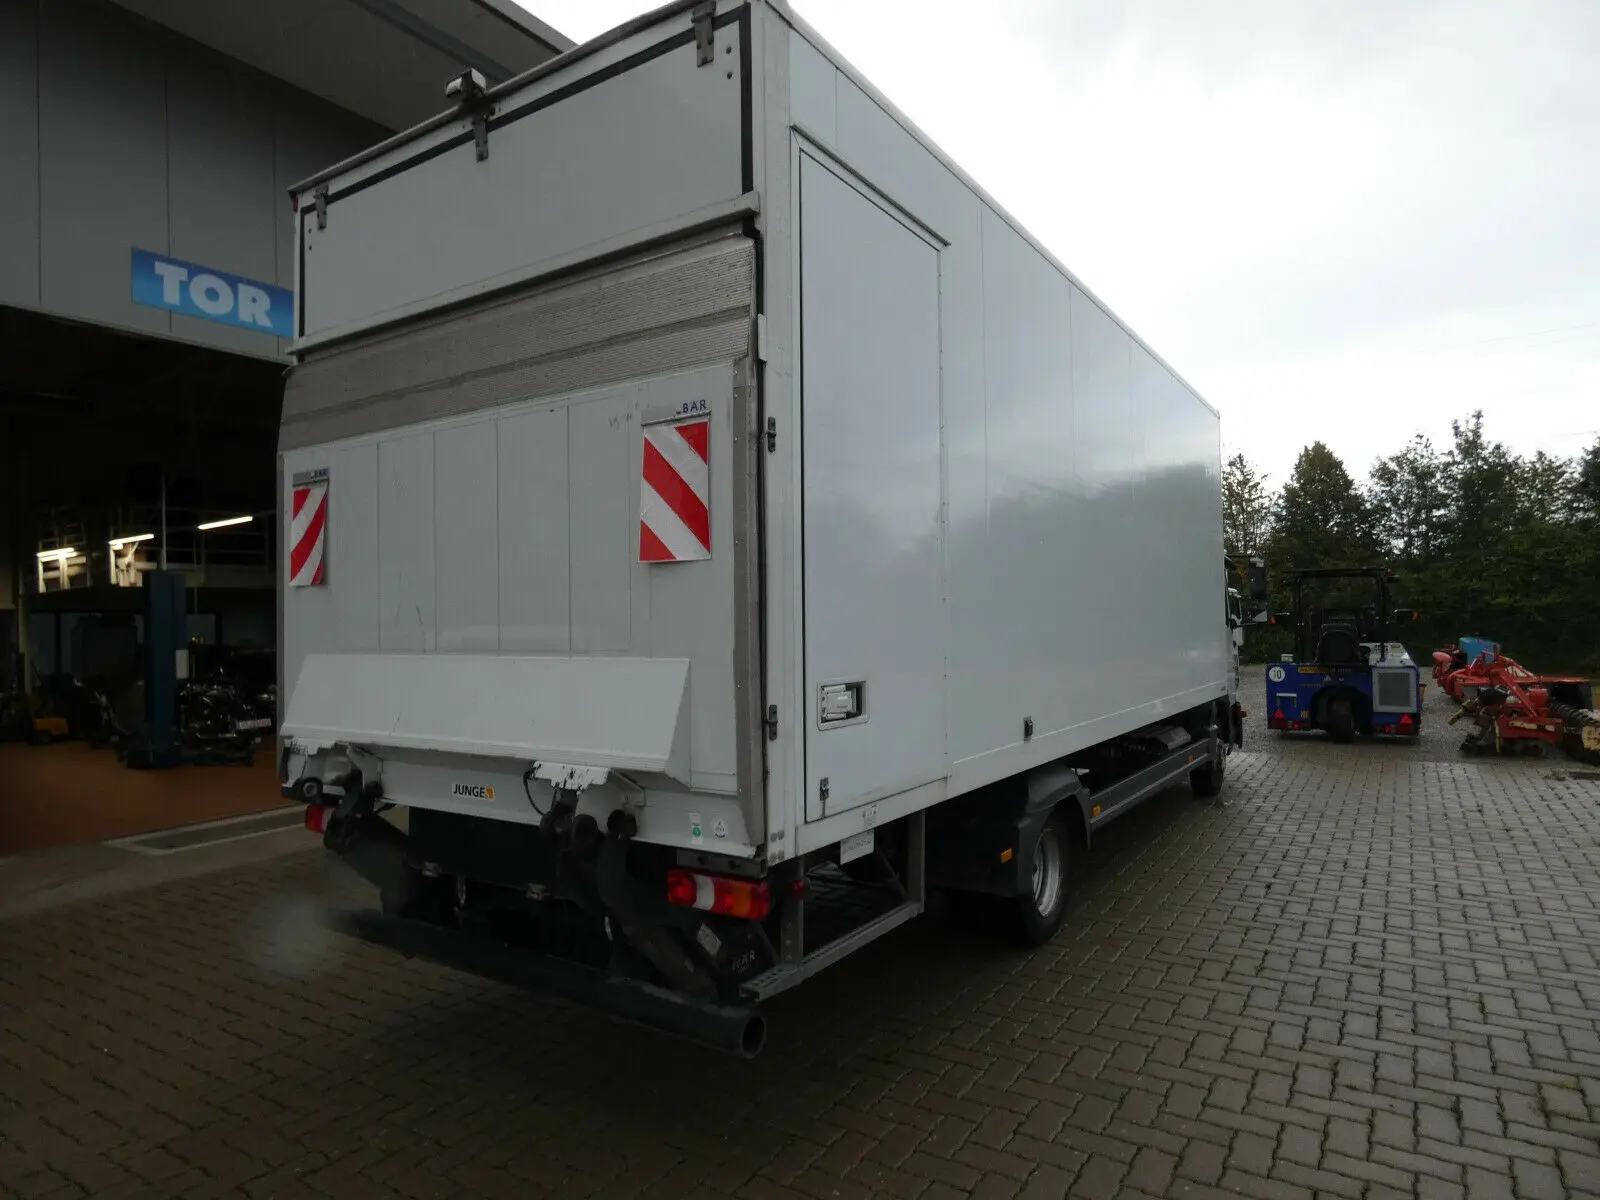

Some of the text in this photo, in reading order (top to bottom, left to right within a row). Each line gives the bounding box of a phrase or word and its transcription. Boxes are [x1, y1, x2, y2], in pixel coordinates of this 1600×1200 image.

[154, 260, 273, 329] TOR
[1273, 670, 1282, 680] 10
[453, 783, 486, 799] JUNGE
